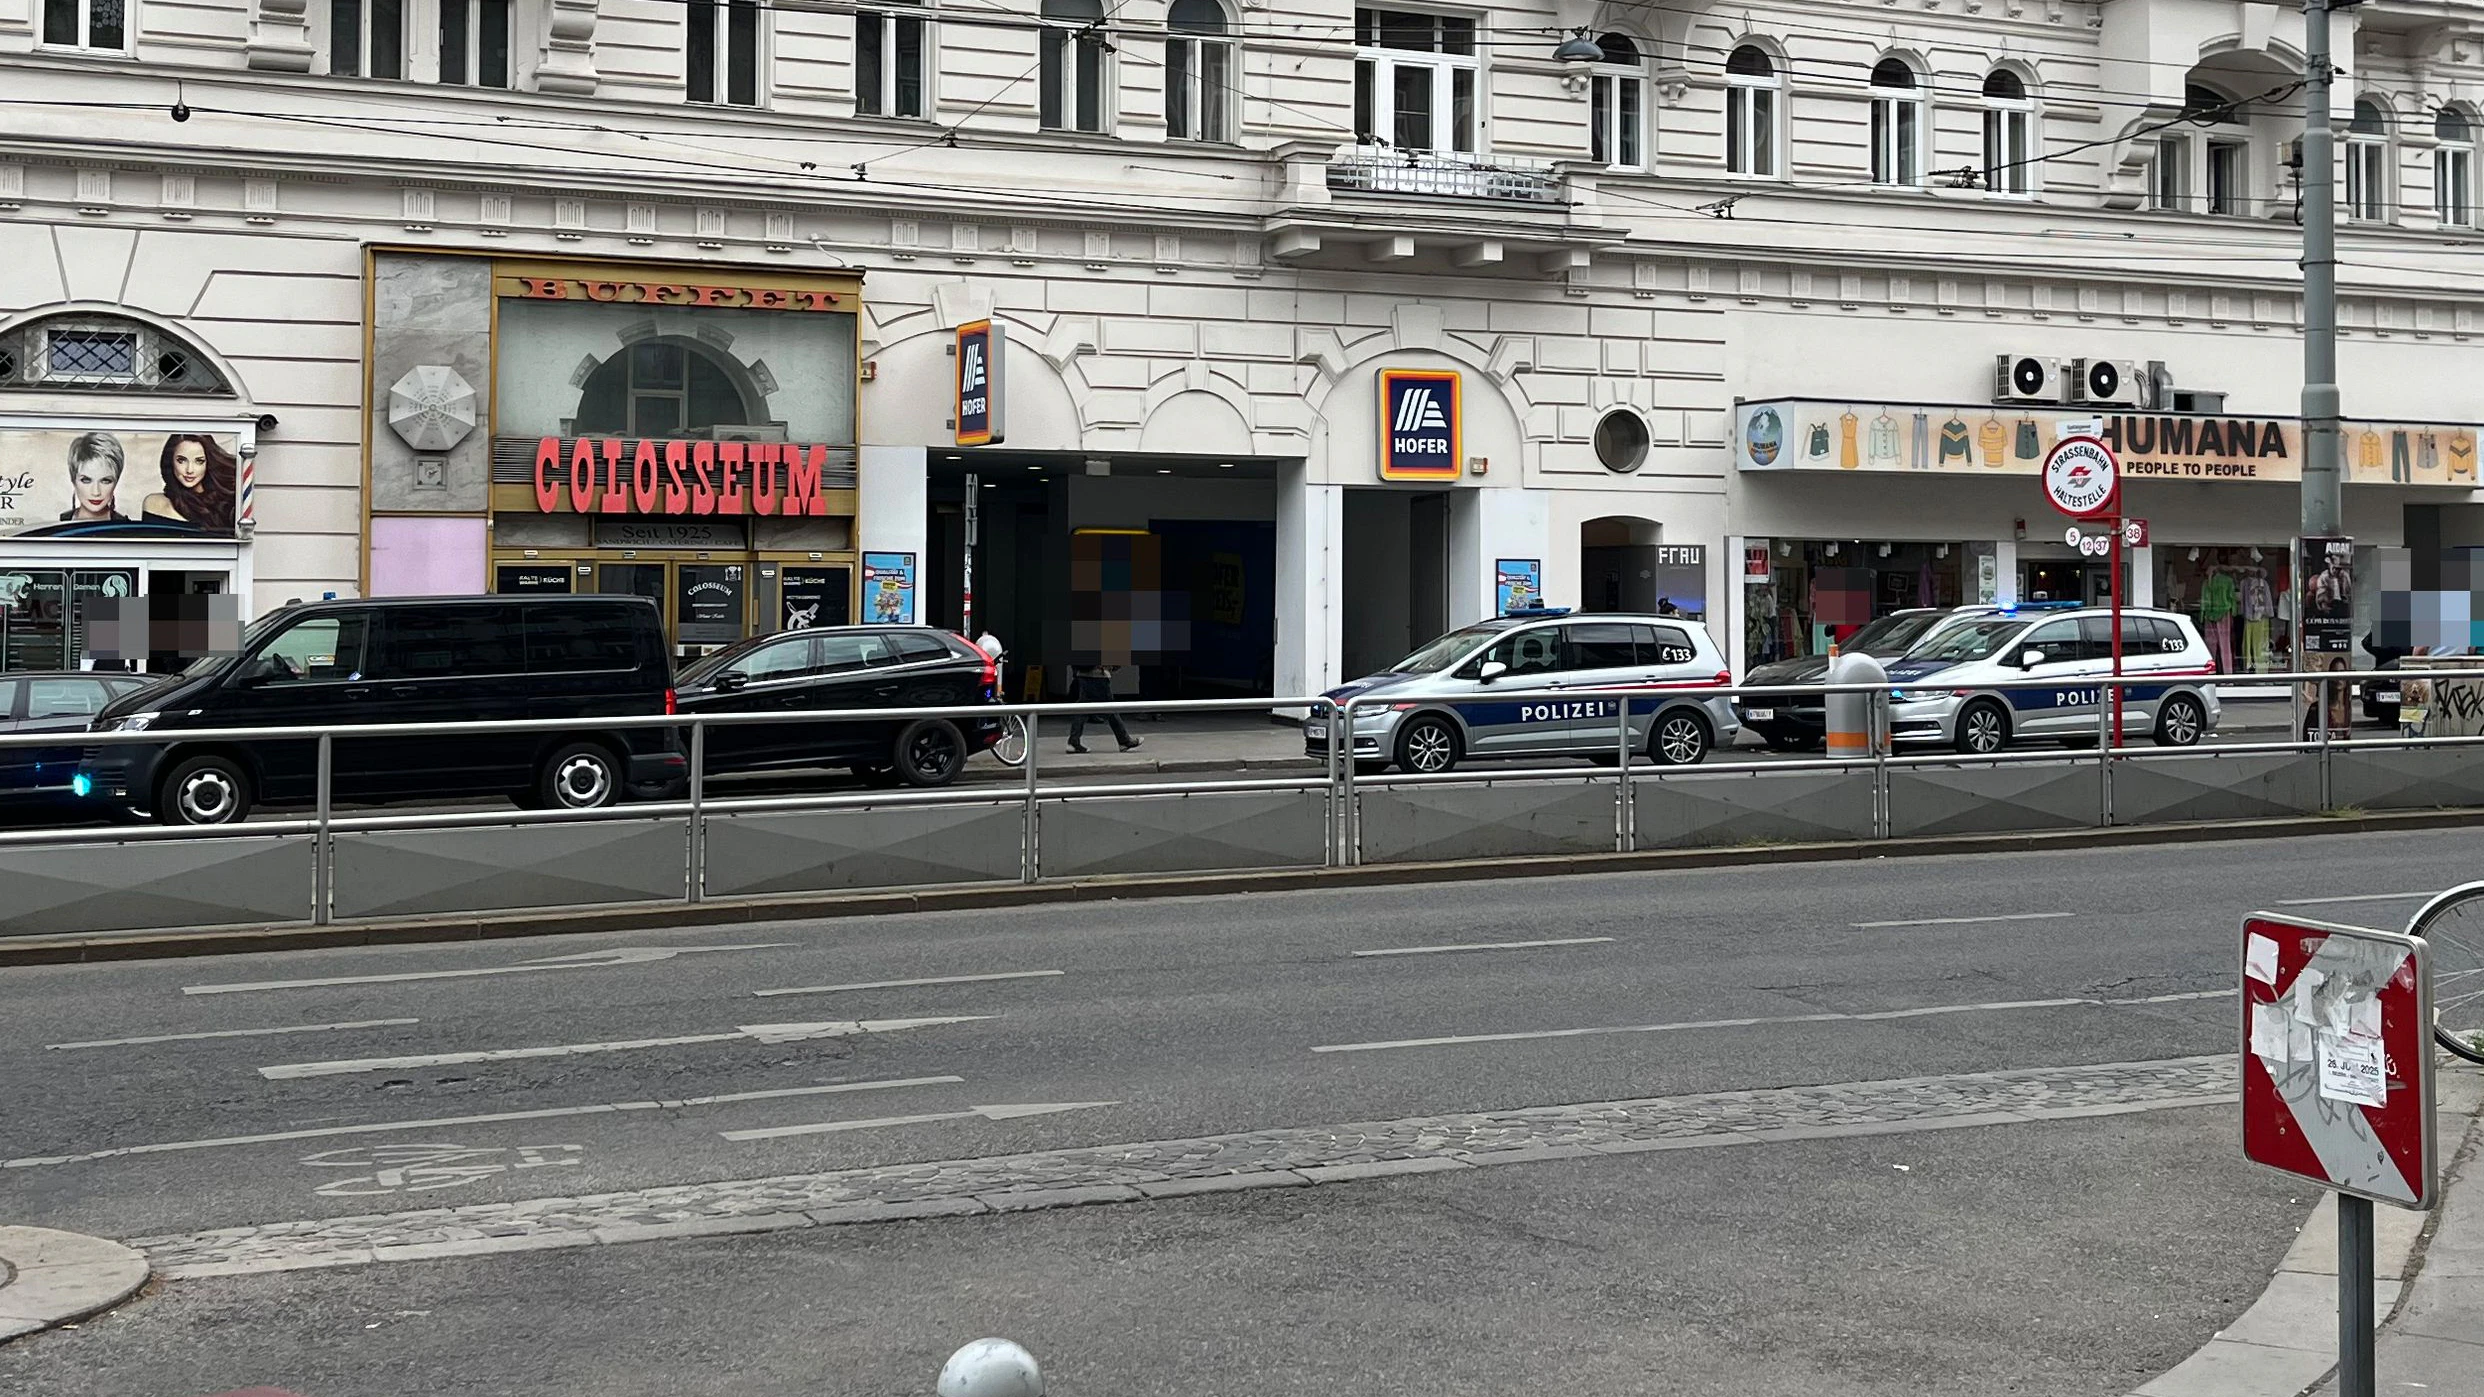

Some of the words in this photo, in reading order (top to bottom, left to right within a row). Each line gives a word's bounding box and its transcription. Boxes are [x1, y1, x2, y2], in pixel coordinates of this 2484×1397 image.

[519, 276, 840, 312] BUFFET
[962, 397, 986, 416] HOFER
[2093, 414, 2288, 459] HUMANA
[1394, 437, 1449, 454] HOFER
[2051, 445, 2110, 474] STRASSENBAHN
[534, 436, 827, 516] COLOSSEUM
[2127, 461, 2179, 476] PEOPLE
[2182, 462, 2201, 476] TO
[2205, 463, 2257, 478] PEOPLE
[2053, 483, 2107, 508] HALTESTELLE
[622, 525, 660, 539] Seit
[667, 525, 712, 540] 1925
[2070, 531, 2076, 543] 5
[2127, 528, 2141, 539] 38
[2082, 541, 2092, 552] 12
[2095, 540, 2108, 551] 37
[687, 582, 733, 597] COLOSSEUM
[2168, 638, 2185, 651] 133
[1670, 648, 1692, 662] 133
[2056, 688, 2115, 706] POLIE
[1521, 701, 1605, 722] POLIZEI
[2360, 1063, 2379, 1076] 2025
